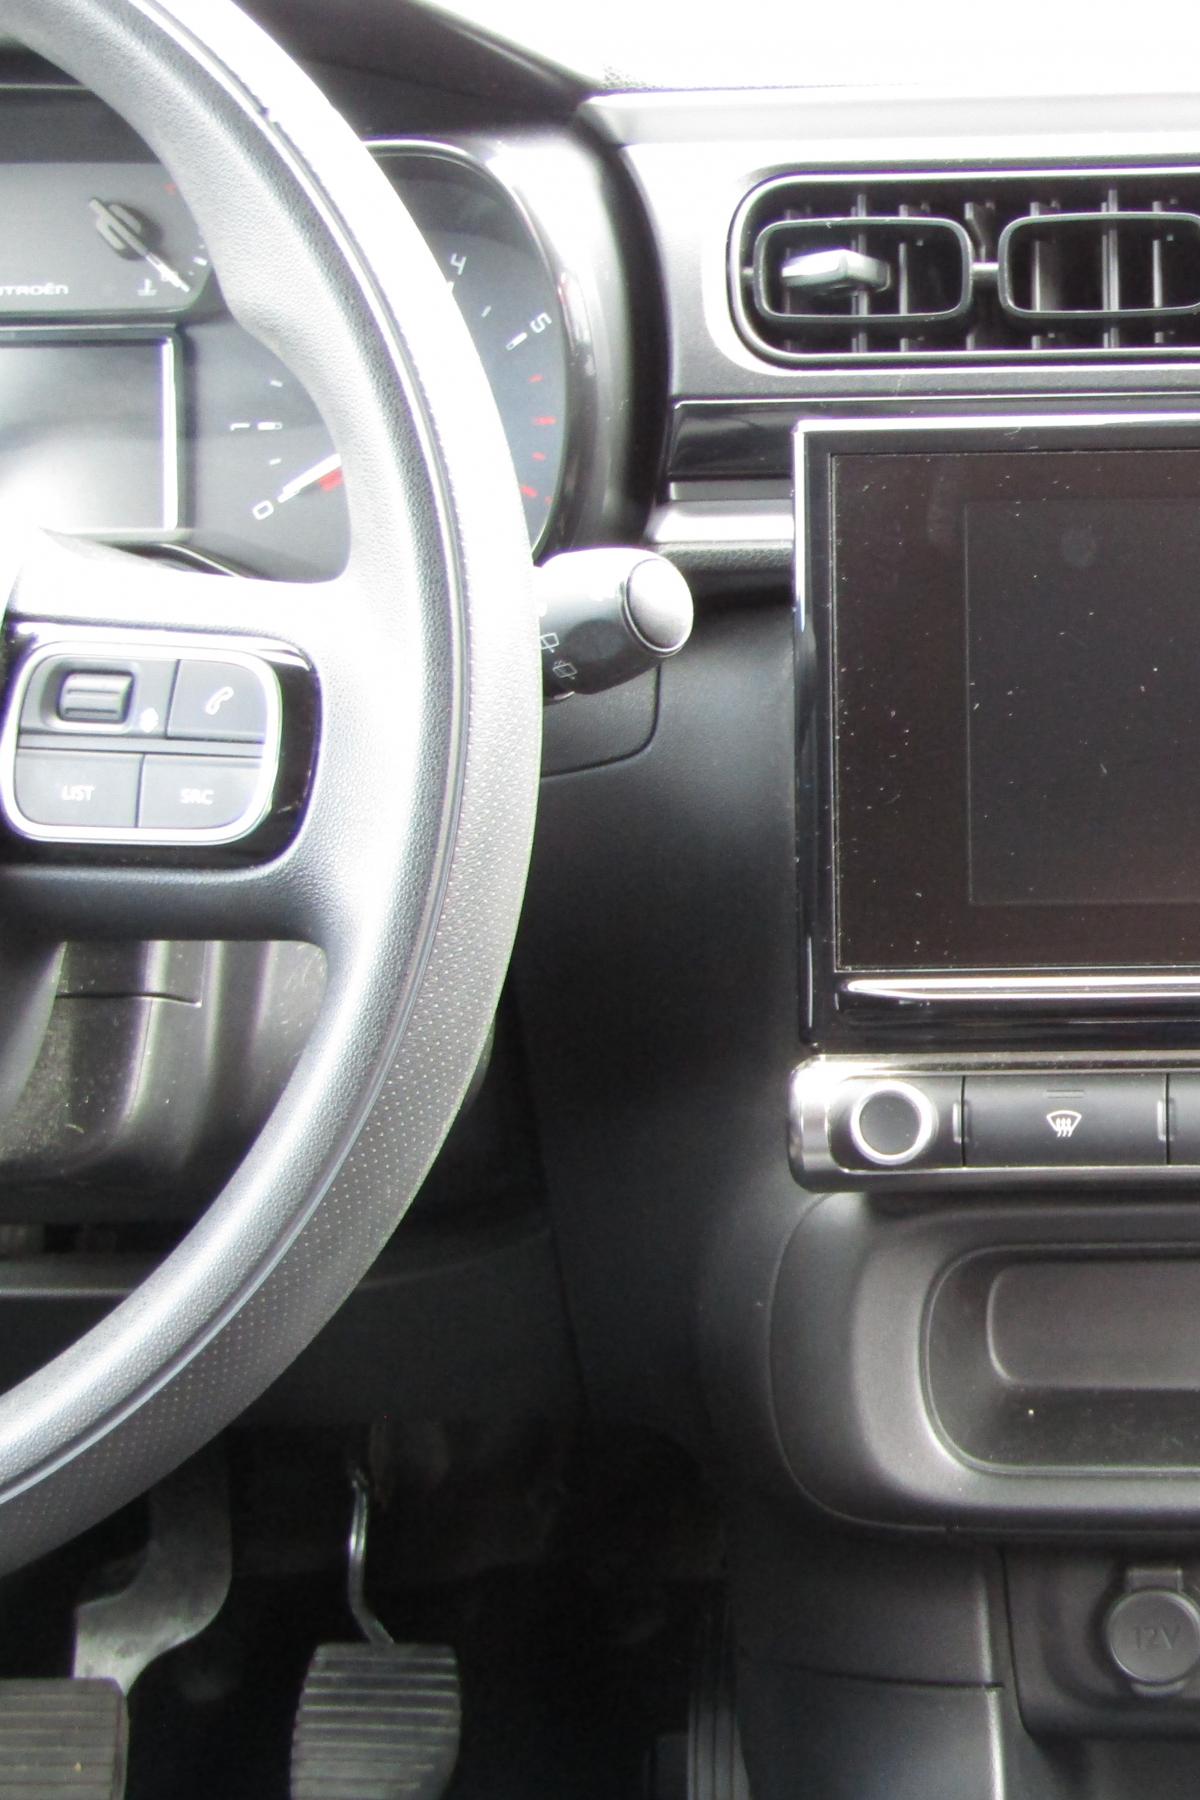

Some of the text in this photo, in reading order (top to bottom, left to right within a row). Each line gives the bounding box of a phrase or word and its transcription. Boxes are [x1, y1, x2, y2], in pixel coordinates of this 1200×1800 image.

[449, 253, 467, 276] 4
[529, 312, 553, 333] 5
[252, 500, 274, 520] 0
[60, 784, 96, 802] LIST
[179, 787, 215, 806] SRC
[1133, 1623, 1181, 1650] 12V
